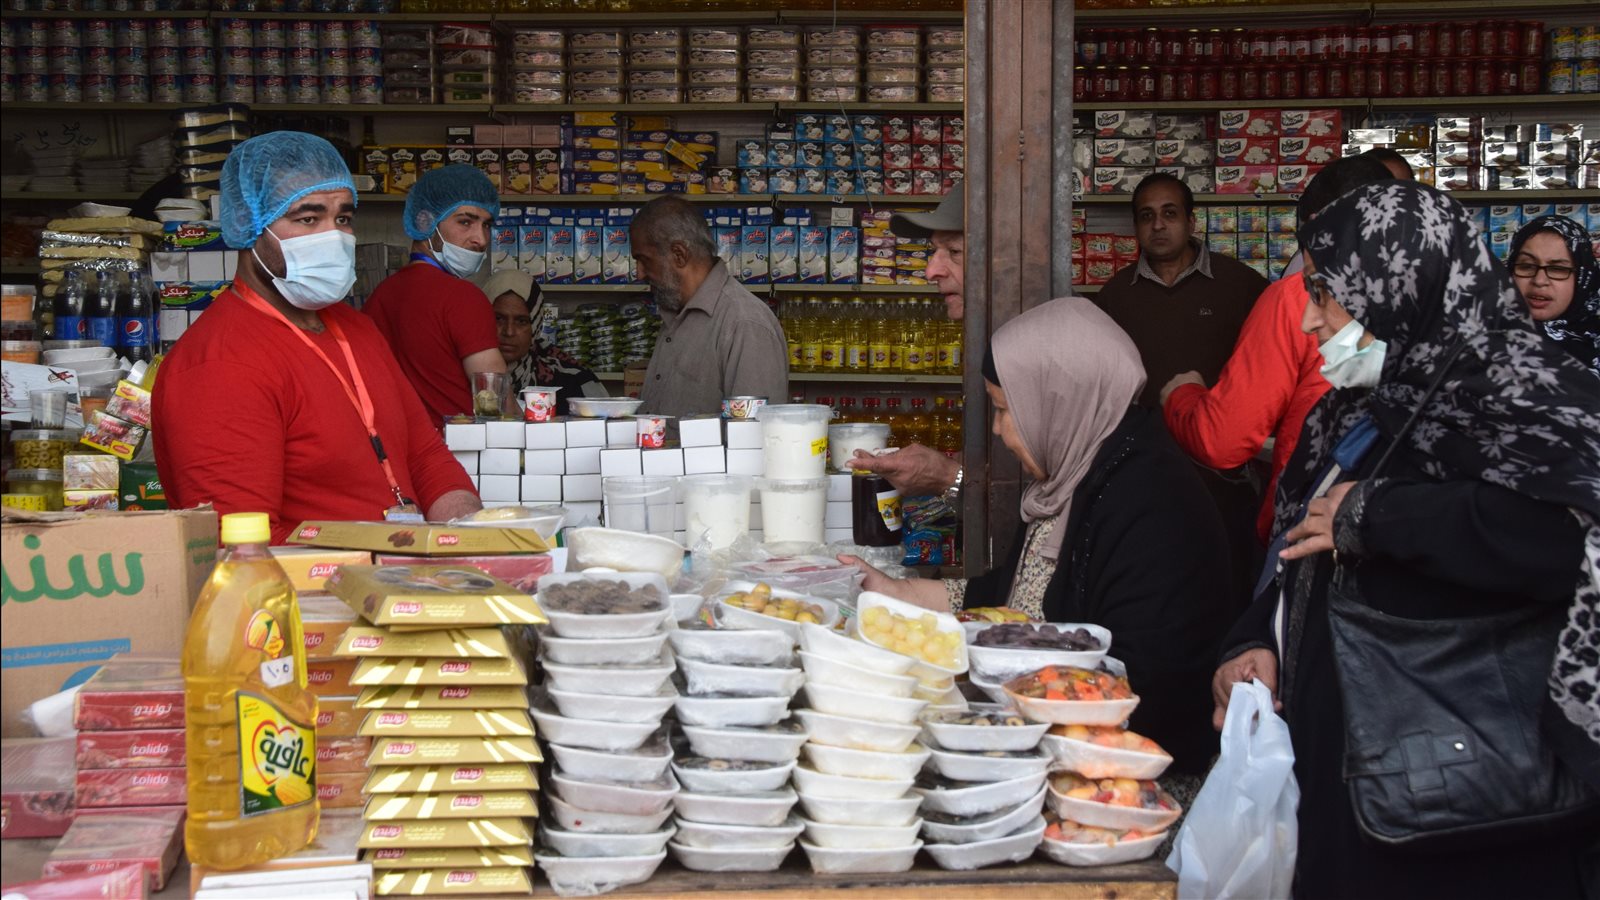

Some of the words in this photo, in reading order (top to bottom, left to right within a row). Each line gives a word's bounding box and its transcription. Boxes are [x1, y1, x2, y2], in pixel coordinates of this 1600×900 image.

[132, 743, 168, 755] tolido
[259, 729, 310, 778] عافية
[132, 774, 168, 786] tolido
